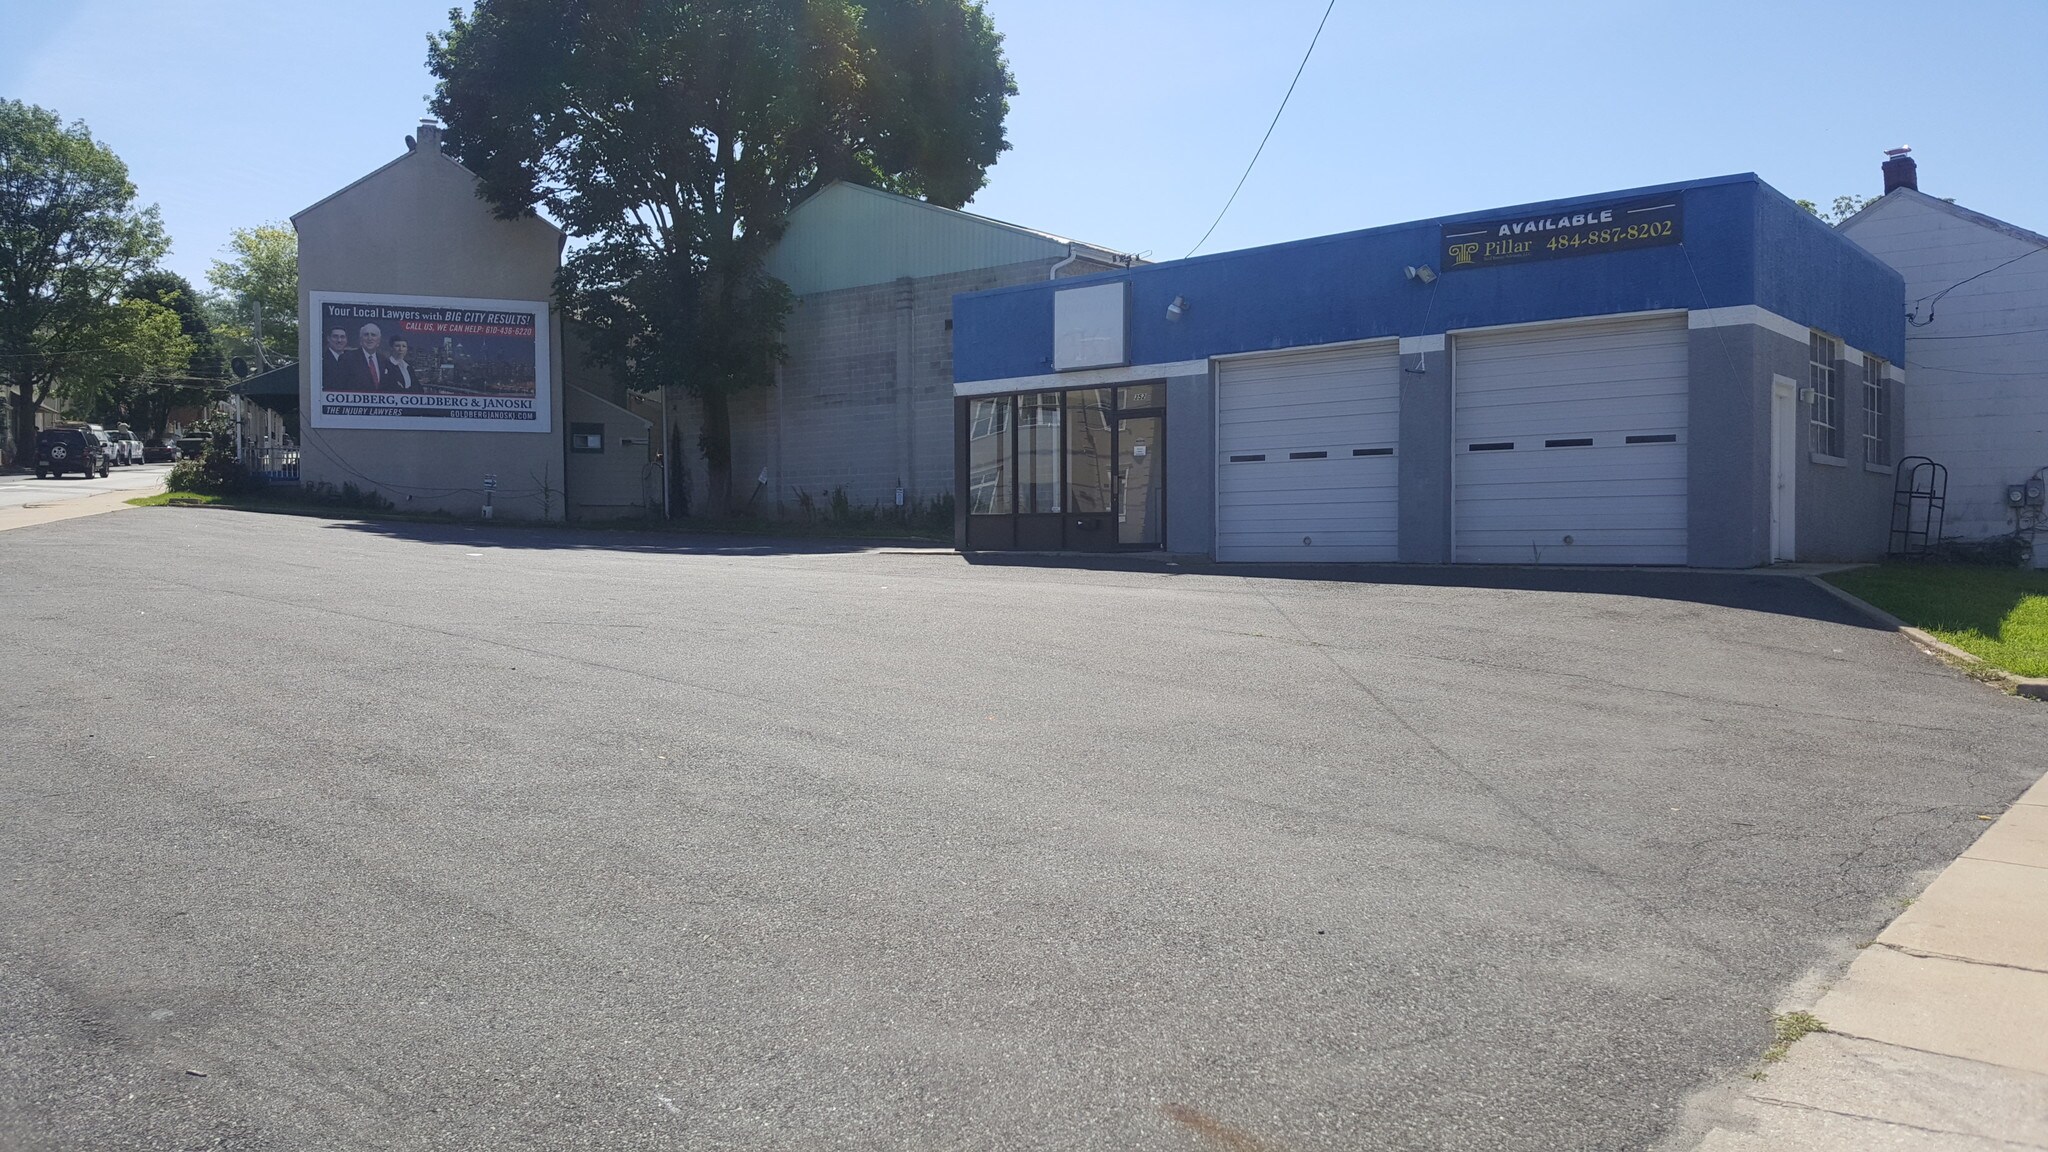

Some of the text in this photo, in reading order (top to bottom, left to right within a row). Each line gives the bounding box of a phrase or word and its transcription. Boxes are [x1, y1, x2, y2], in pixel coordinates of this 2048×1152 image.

[1499, 209, 1613, 236] AVAILABLE
[1546, 220, 1672, 252] 484-887-8202
[1484, 239, 1532, 256] Pillar
[329, 305, 531, 325] Your Local Lawyers with BIG CITY RESULTS!
[405, 322, 422, 330] CALL
[423, 323, 435, 331] US,
[449, 324, 463, 332] CAN
[326, 393, 532, 409] GOLDBERG, GOLDBERG & JANOSKI
[326, 406, 403, 416] THE INJURY LAWYERS
[450, 410, 533, 420] GOLDBERGJANOSKI.COM
